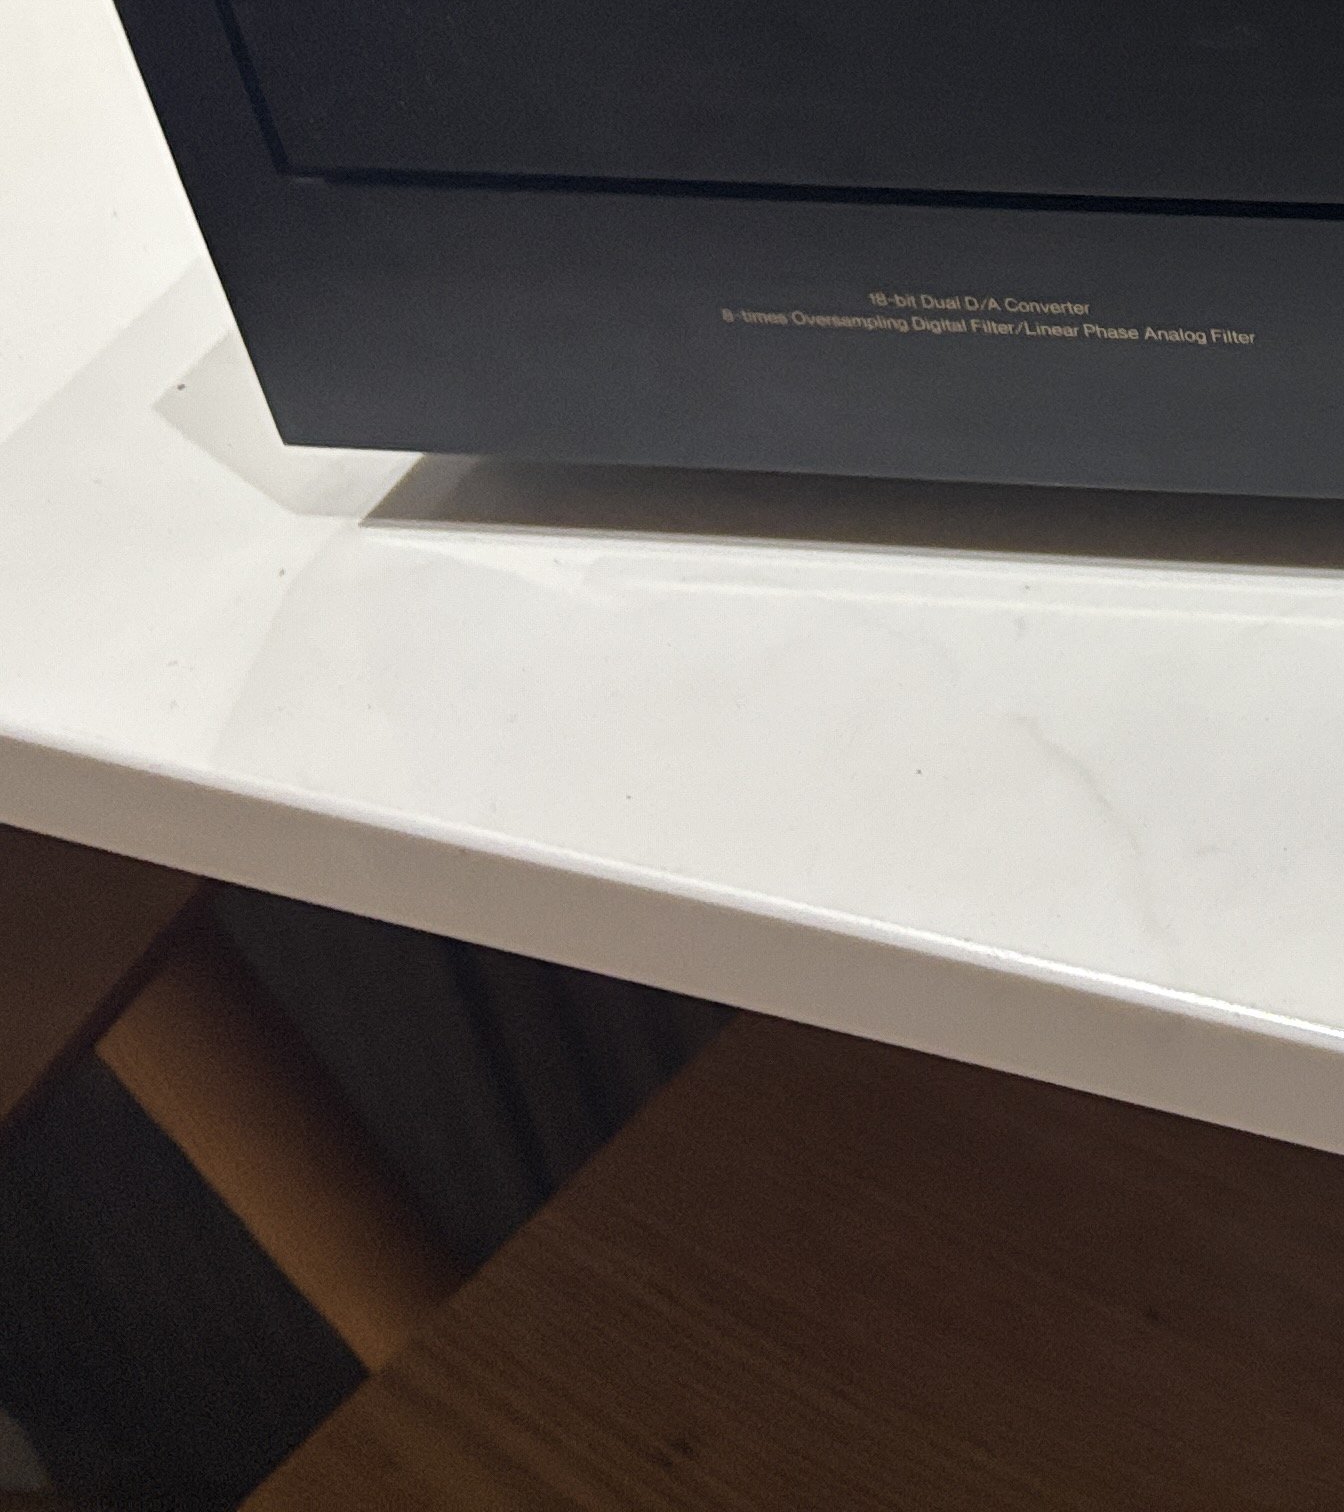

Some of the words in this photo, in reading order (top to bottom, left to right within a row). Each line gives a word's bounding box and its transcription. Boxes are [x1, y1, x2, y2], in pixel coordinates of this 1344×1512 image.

[868, 291, 916, 308] 18-bit
[920, 293, 960, 311] Dual
[964, 295, 1000, 312] D/A
[1004, 297, 1091, 316] Converter
[791, 310, 909, 334] Oversampling
[911, 315, 967, 335] Digital
[970, 318, 1079, 338] Filter/Linear
[1082, 322, 1140, 340] Phase
[1144, 326, 1208, 345] Analog
[1209, 327, 1256, 345] Filter
